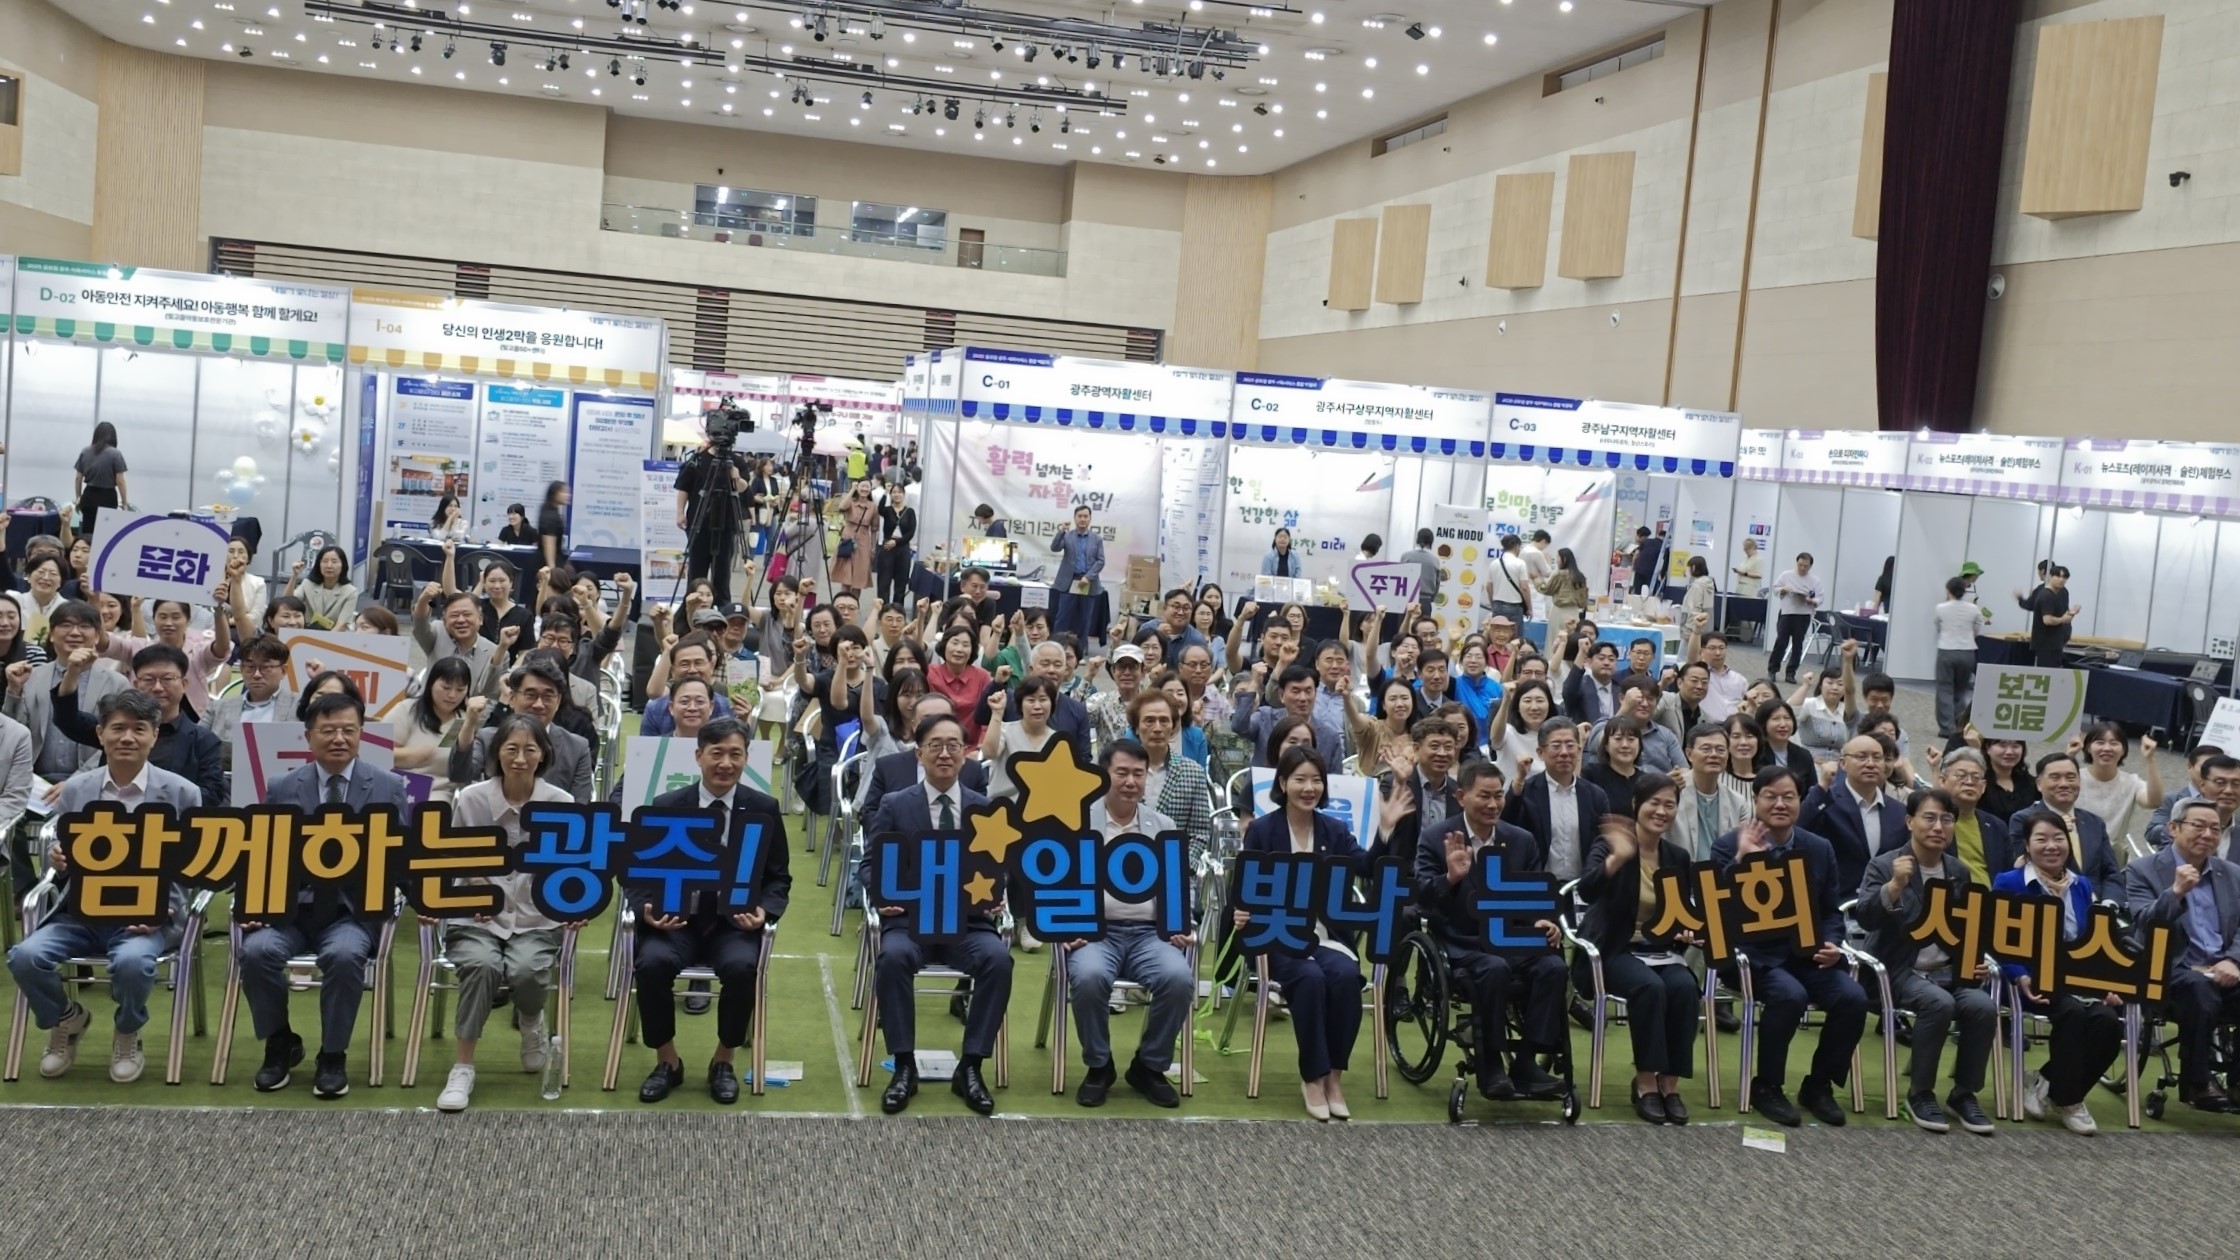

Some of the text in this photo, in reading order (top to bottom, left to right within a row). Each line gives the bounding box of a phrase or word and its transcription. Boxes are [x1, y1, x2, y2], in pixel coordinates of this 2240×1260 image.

[40, 287, 318, 323] D-02 아동안전 지켜주세요! 아동행복 함께 할게요!
[442, 323, 478, 339] 당신의
[482, 327, 538, 346] 인생2막을
[541, 332, 604, 350] 응원합니다!
[982, 375, 1153, 402] C-01 광주광역자활센터
[1251, 397, 1435, 421] C-02 광주서구상무지역자활센터
[1509, 418, 1677, 441] C-03 광주남구지역자활센터
[987, 445, 1074, 480] 활력 넘치는
[2074, 462, 2093, 475] K-01
[1239, 507, 1279, 526] 건강한
[1321, 537, 1346, 551] 미래
[1436, 526, 1484, 542] ANG HODU
[136, 544, 210, 586] 문화
[1369, 574, 1408, 597] 주거
[1997, 671, 2051, 702] 보건
[1992, 703, 2047, 733] 의료
[68, 809, 505, 917] 함께하는
[523, 810, 765, 914] 광주!
